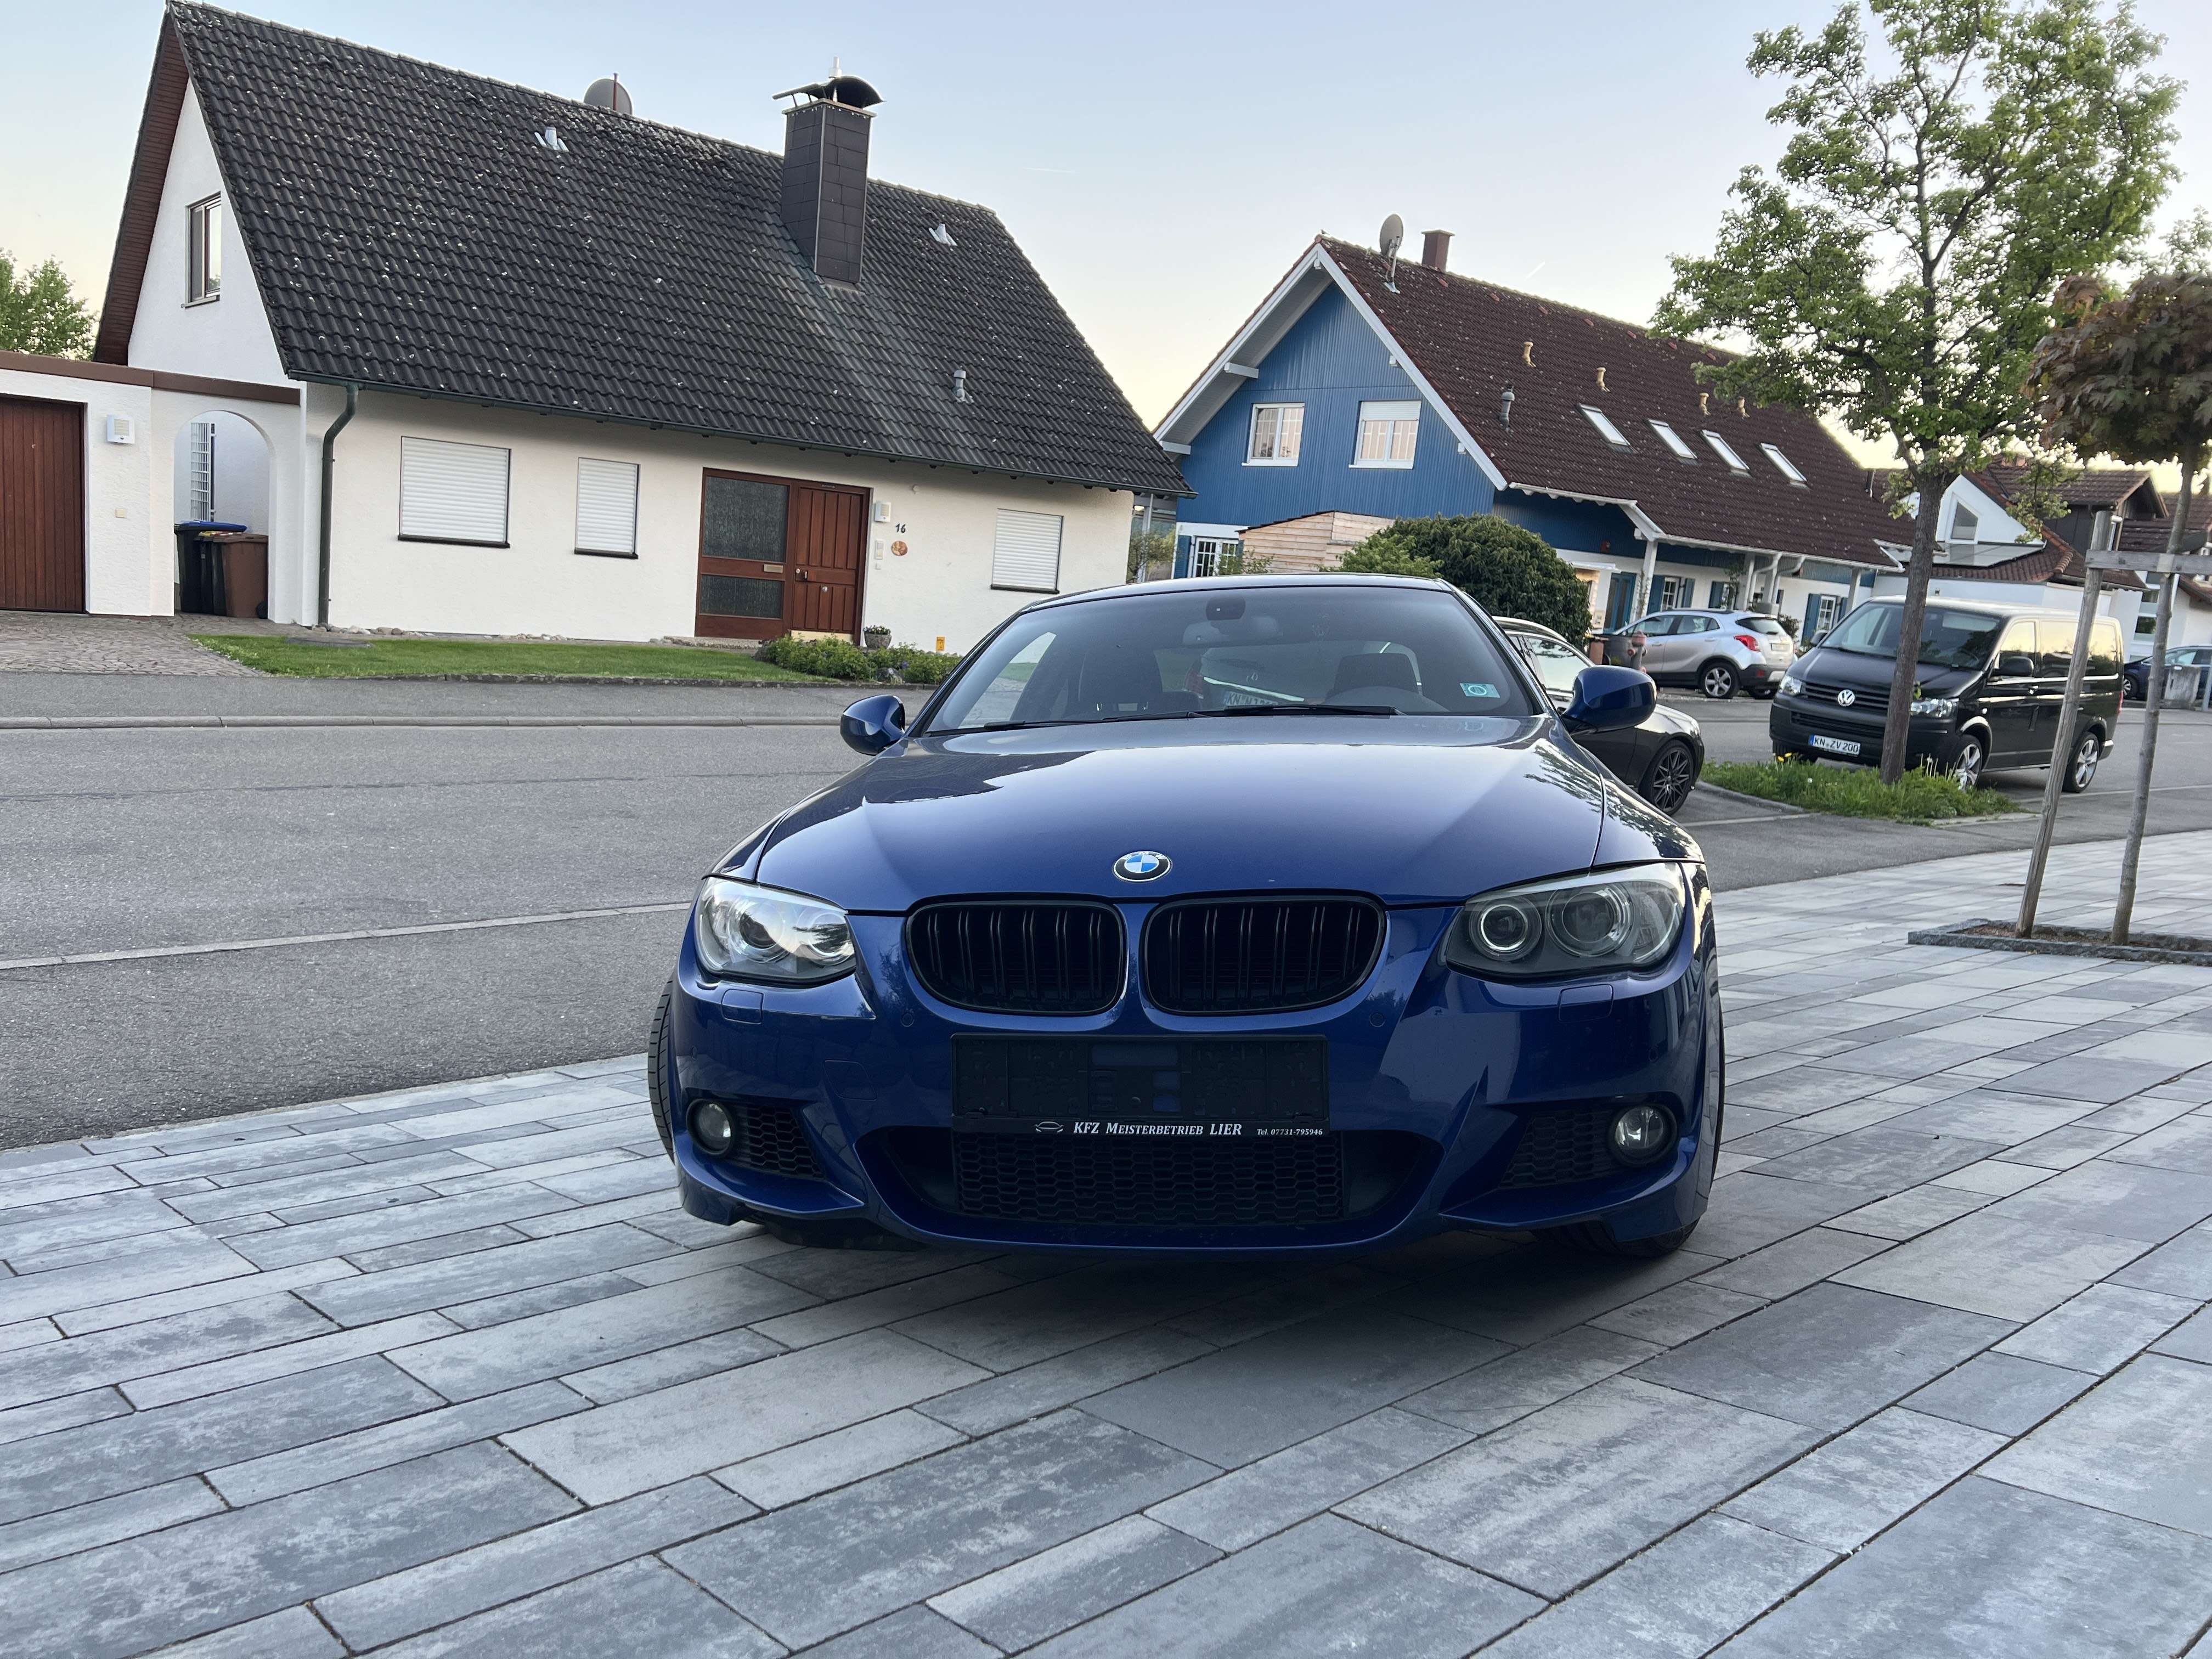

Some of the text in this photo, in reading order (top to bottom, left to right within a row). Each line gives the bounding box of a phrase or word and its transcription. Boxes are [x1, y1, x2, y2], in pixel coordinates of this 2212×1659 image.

[895, 523, 906, 533] 16
[1814, 737, 1859, 752] KN ZV 200
[1074, 1121, 1100, 1134] KFZ
[1105, 1122, 1204, 1135] MEISTERBETRIEB
[1209, 1123, 1243, 1136] LIER
